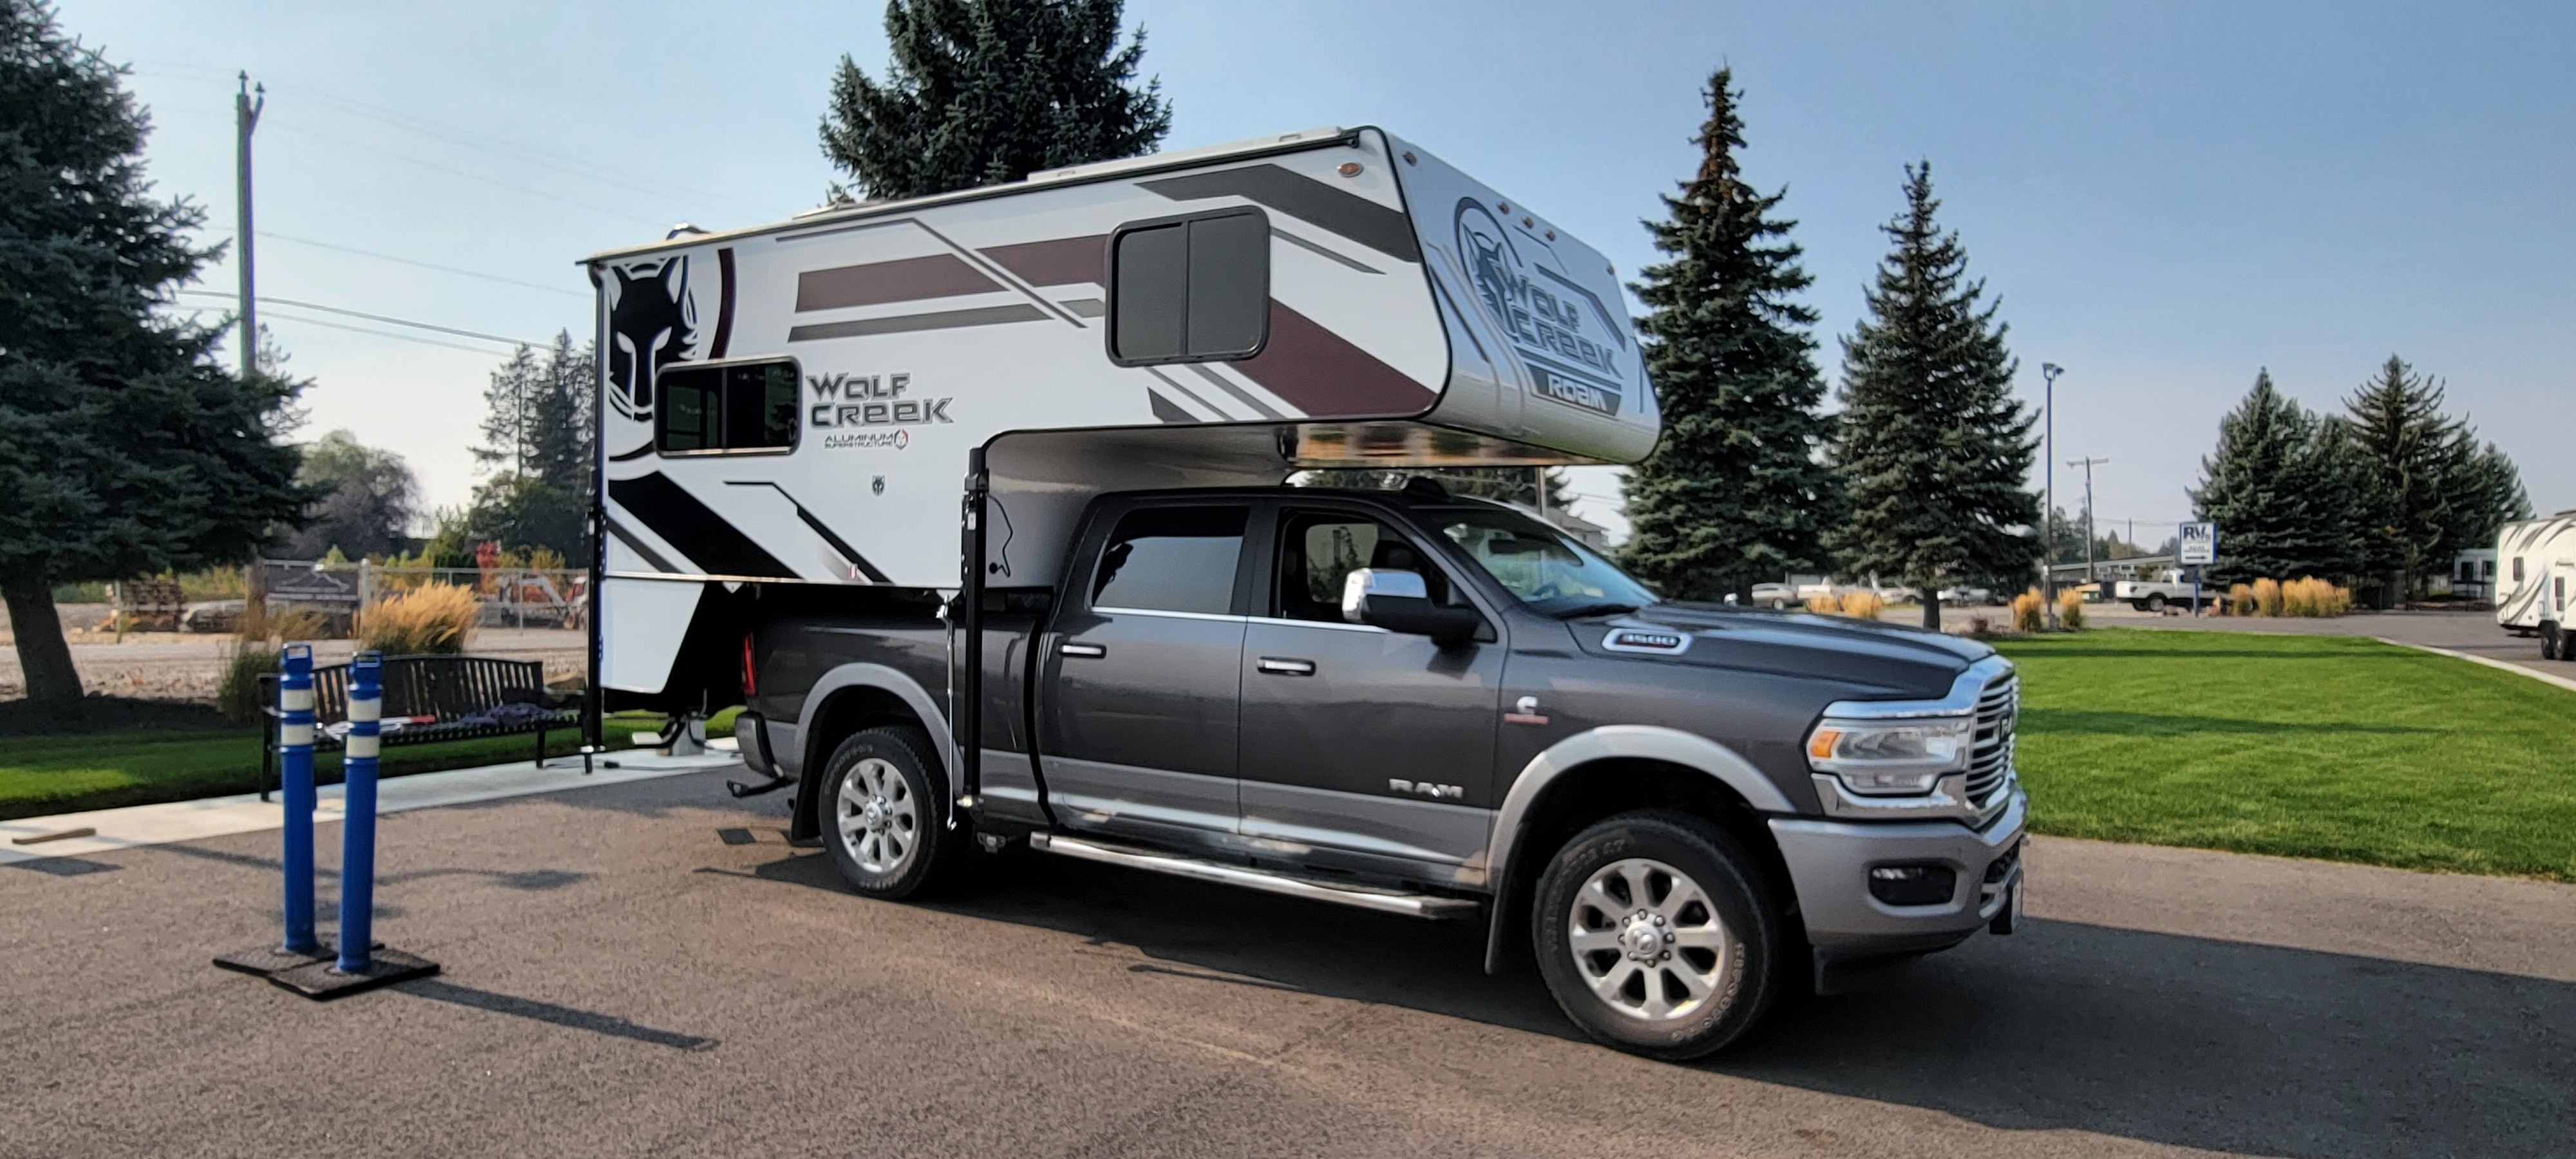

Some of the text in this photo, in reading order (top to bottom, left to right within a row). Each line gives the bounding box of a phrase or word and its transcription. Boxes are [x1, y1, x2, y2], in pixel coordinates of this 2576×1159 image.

[1487, 258, 1580, 333] WOLF
[1510, 305, 1624, 380] CREEK
[806, 372, 911, 401] WOLF
[1547, 373, 1607, 411] ROAM
[810, 397, 954, 429] CREEK
[824, 433, 893, 443] ALUMINUM
[1389, 778, 1463, 798] RAM
